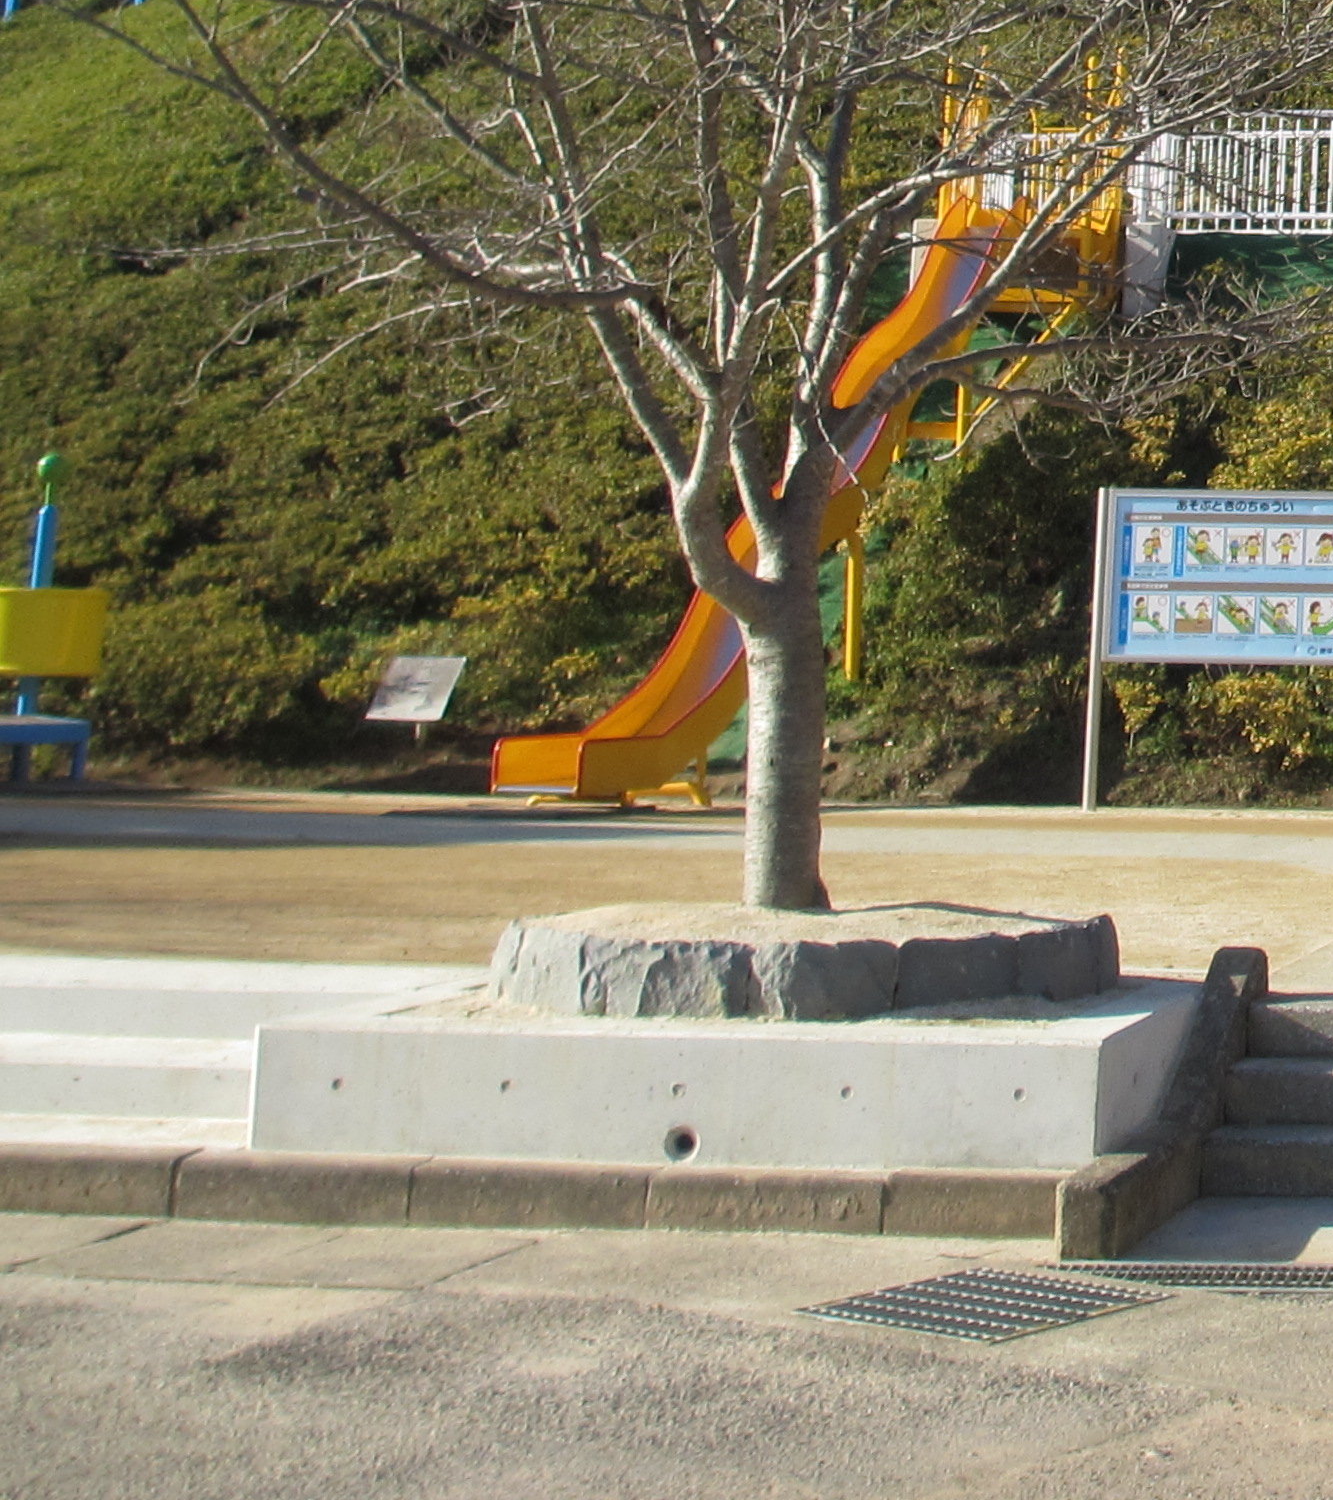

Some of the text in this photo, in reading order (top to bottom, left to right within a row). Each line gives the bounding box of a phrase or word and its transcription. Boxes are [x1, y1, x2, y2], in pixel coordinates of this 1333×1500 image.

[1176, 500, 1294, 512] あそぶときのちゅうい
